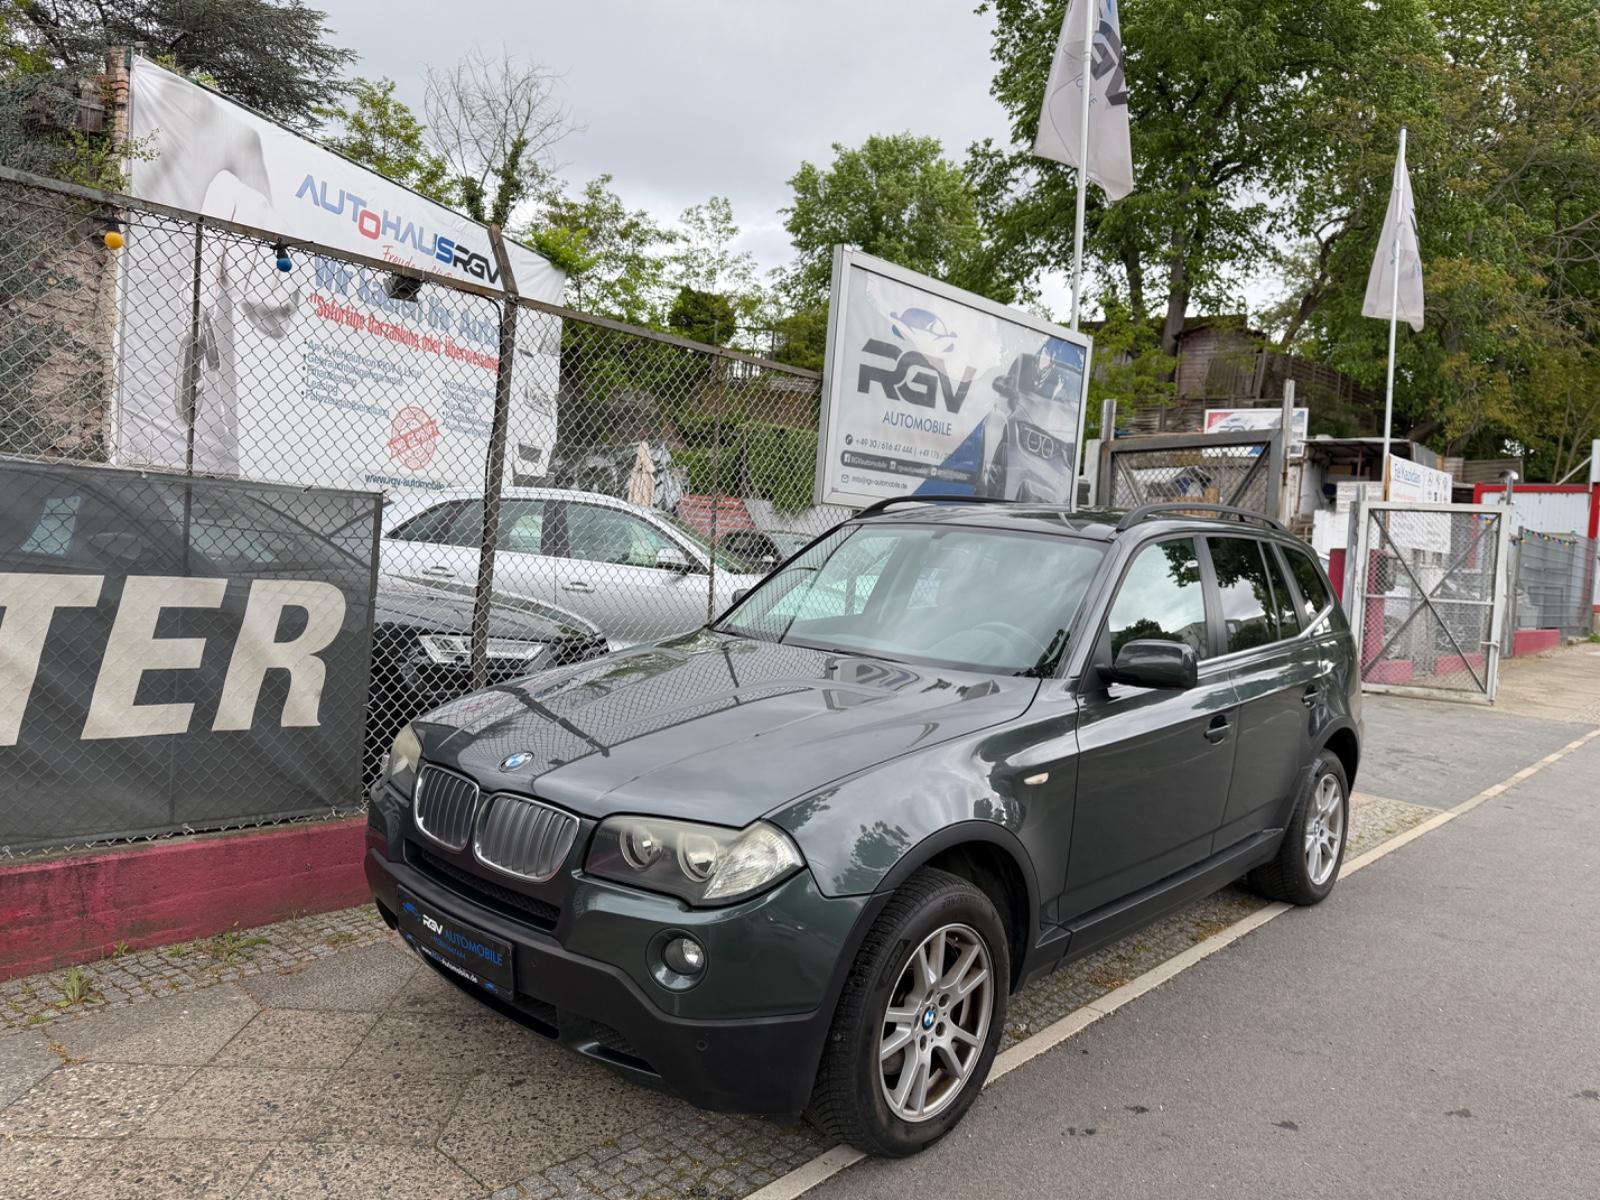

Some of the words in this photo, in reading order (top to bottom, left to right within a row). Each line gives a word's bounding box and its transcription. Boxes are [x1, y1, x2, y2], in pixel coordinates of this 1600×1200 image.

[857, 338, 977, 414] RGV
[882, 411, 952, 436] AUTOMOBILE
[422, 914, 443, 935] RGV
[444, 929, 503, 966] AUTOMOBILE
